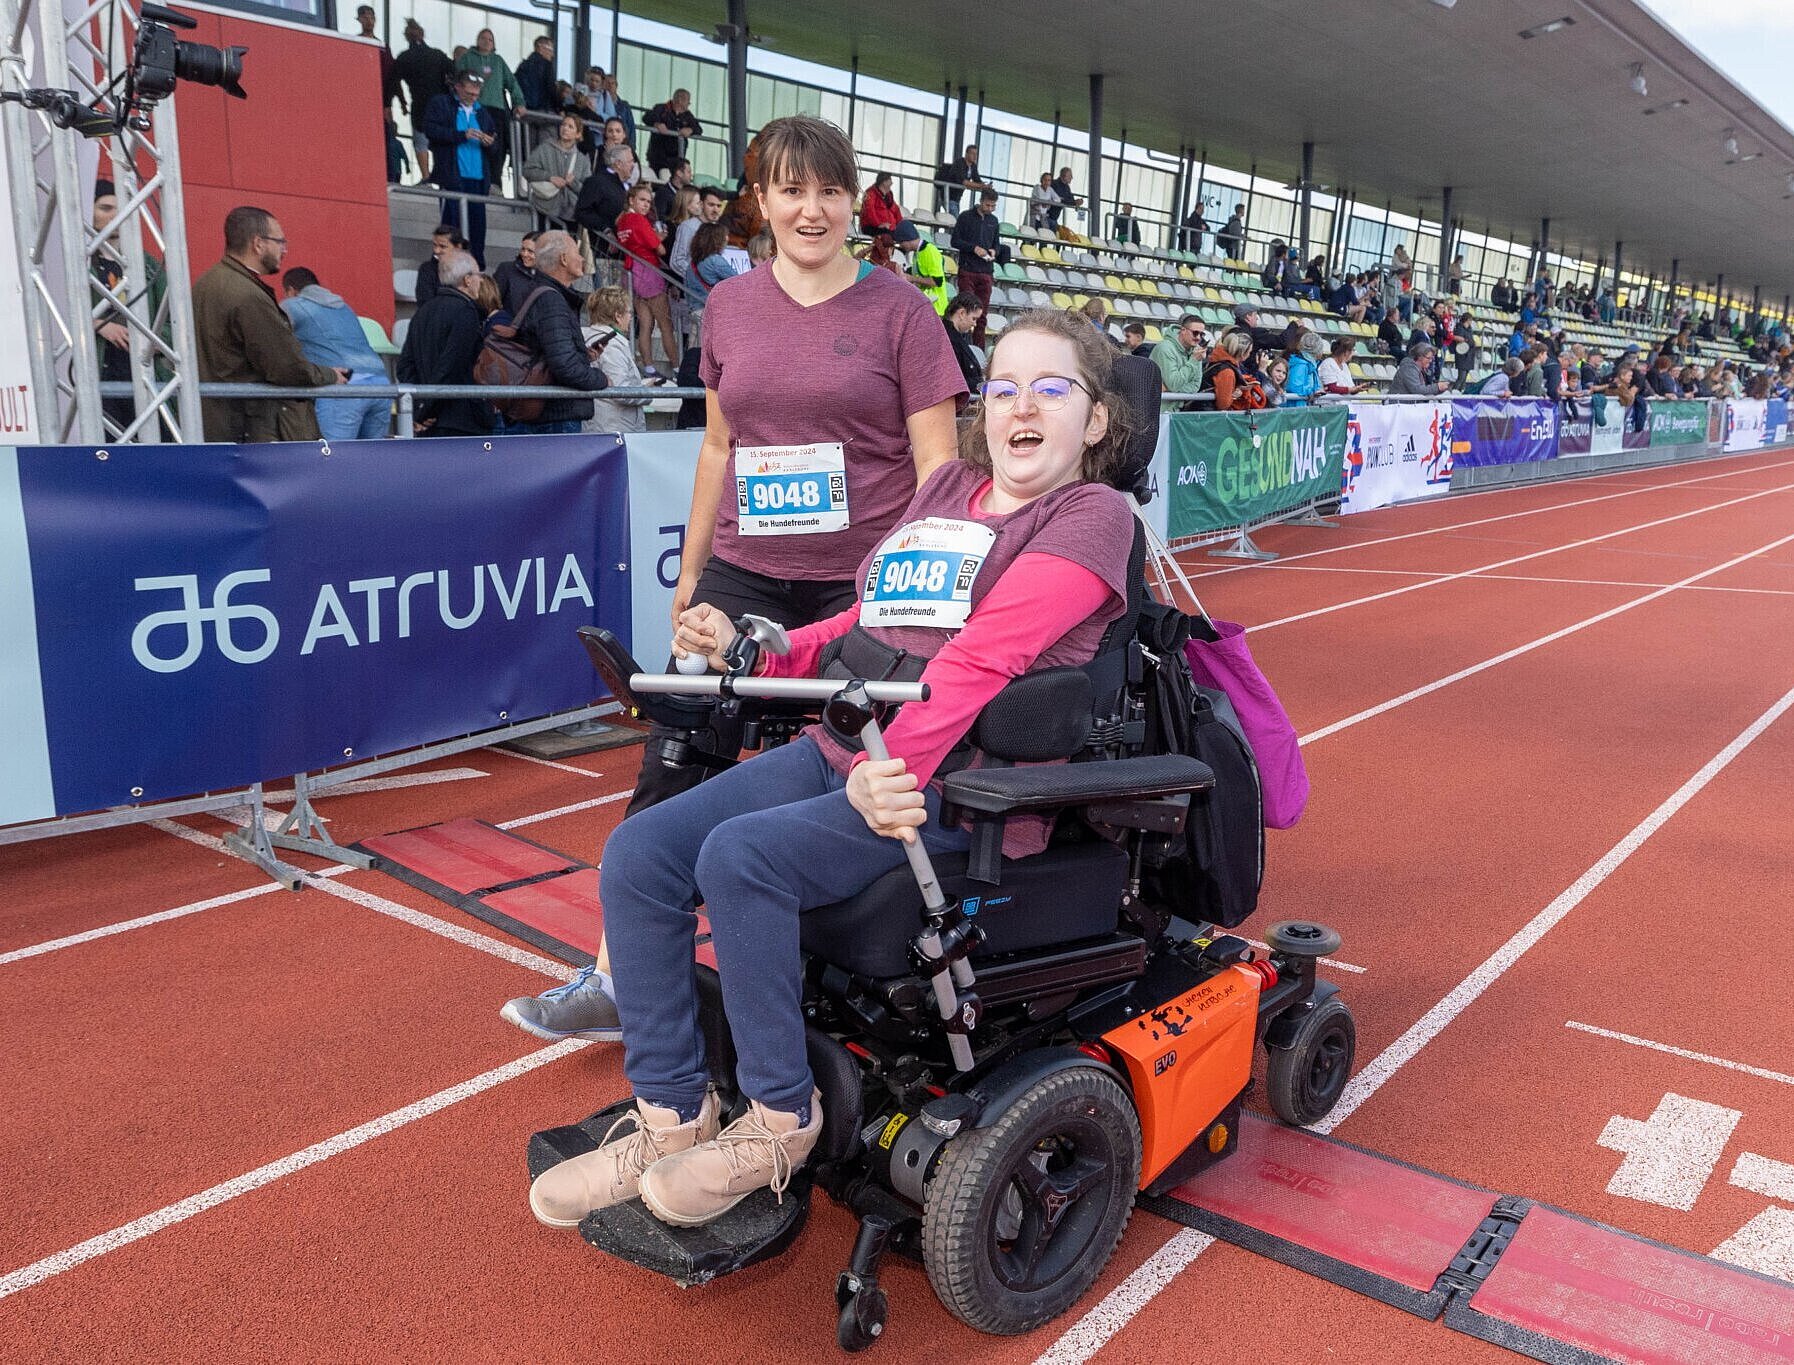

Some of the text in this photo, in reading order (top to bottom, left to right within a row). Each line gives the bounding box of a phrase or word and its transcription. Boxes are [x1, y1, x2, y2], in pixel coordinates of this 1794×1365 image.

[0, 386, 28, 432] ULT
[760, 449, 797, 459] September
[799, 447, 817, 456] 2024
[1177, 465, 1199, 487] AOK
[753, 480, 820, 510] 9048
[758, 518, 820, 528] Die Hundefreunde
[944, 522, 964, 533] 2024
[882, 560, 948, 593] 9048
[300, 553, 595, 655] ATRUVIA
[879, 607, 936, 617] Die Hundefreunde
[1155, 1050, 1177, 1077] EVO
